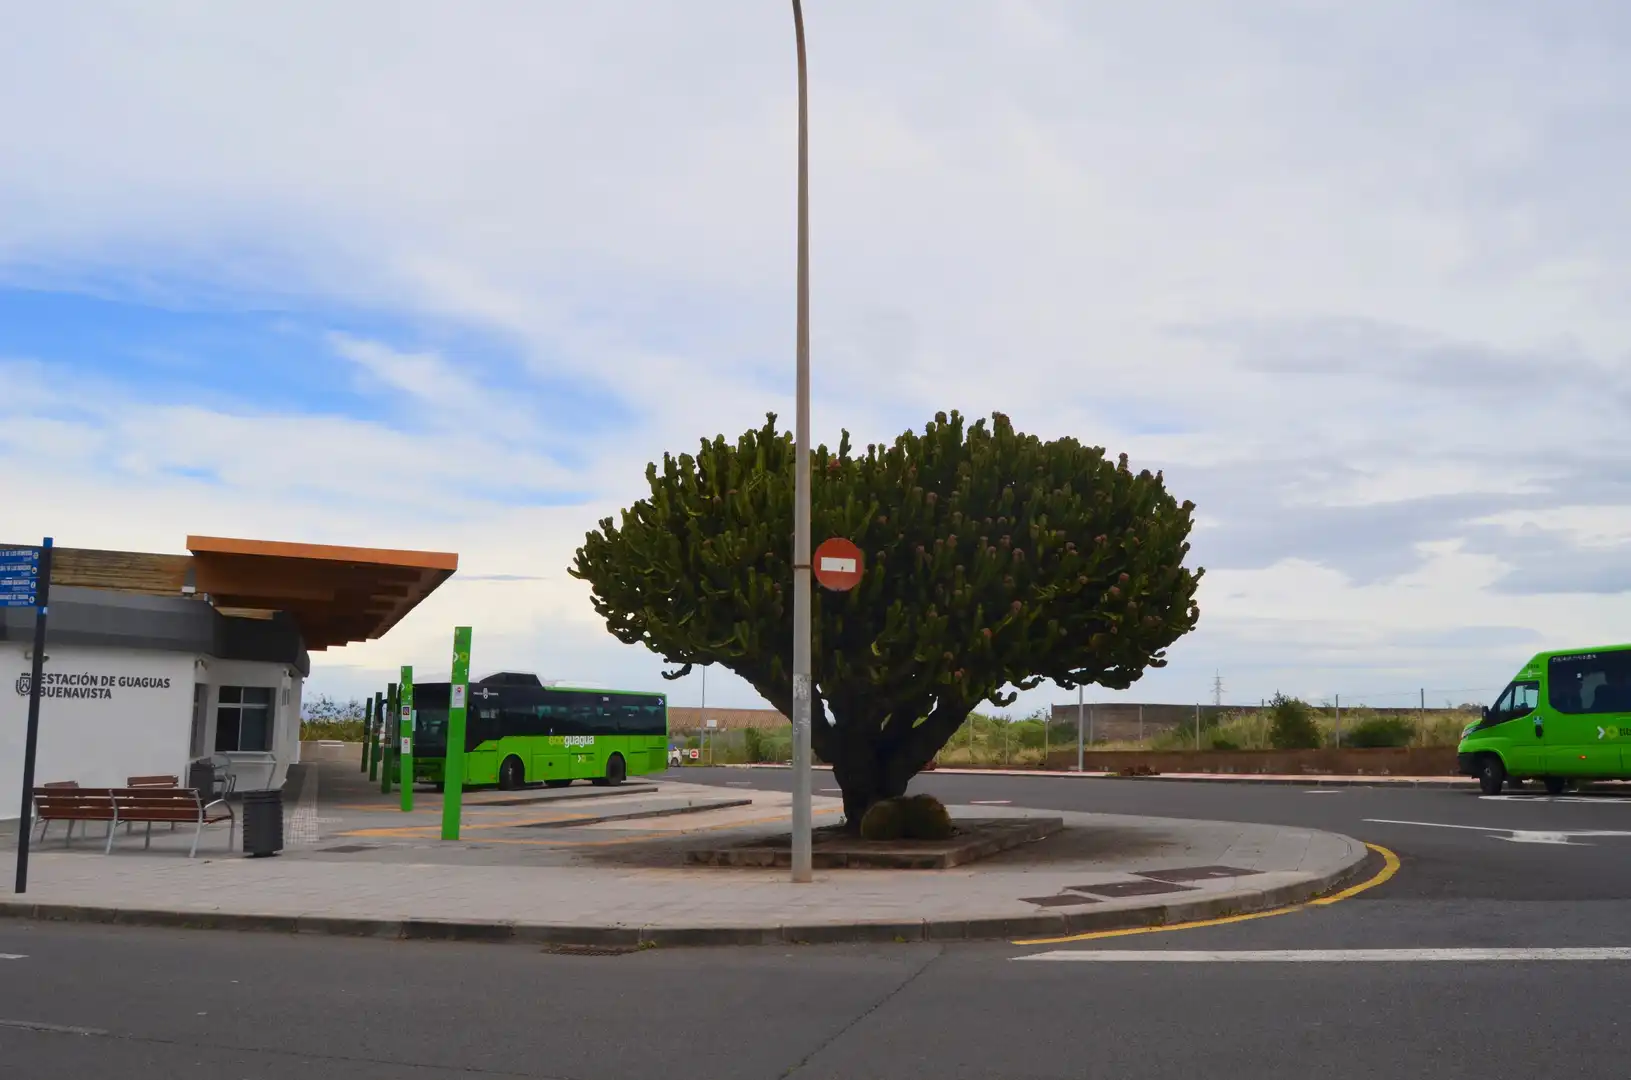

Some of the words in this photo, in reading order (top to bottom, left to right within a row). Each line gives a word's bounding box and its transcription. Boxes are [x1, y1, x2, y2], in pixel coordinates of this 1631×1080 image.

[41, 672, 98, 686] ESTACIÓN
[101, 676, 116, 686] DE
[118, 676, 170, 688] GUAGUAS
[40, 687, 112, 699] BUENAVISTA
